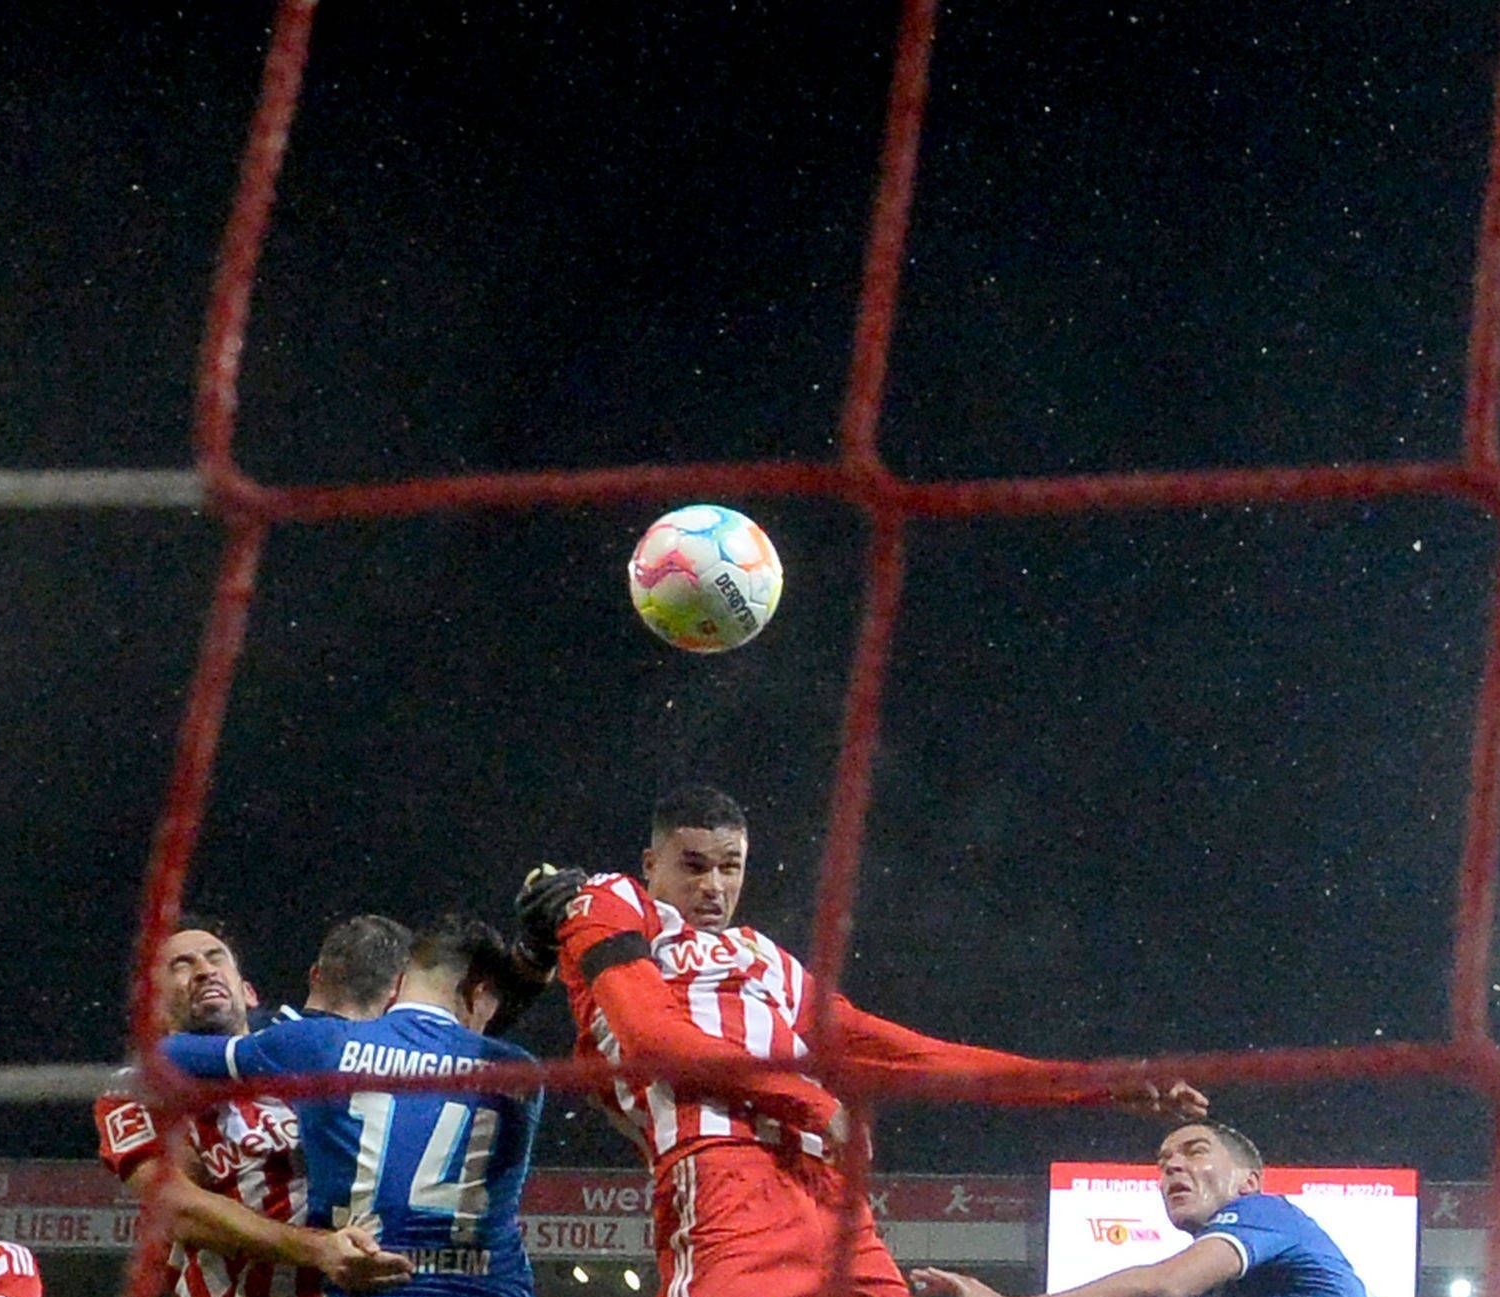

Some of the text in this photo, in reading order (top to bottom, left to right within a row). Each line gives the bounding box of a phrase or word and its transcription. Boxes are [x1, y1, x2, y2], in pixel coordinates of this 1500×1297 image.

[339, 1040, 496, 1078] BAUMGART
[201, 1111, 301, 1178] wefo
[348, 1092, 499, 1245] 14
[582, 1178, 656, 1212] wef
[15, 1212, 100, 1248] LIEBE.
[537, 1222, 626, 1250] STOLZ.
